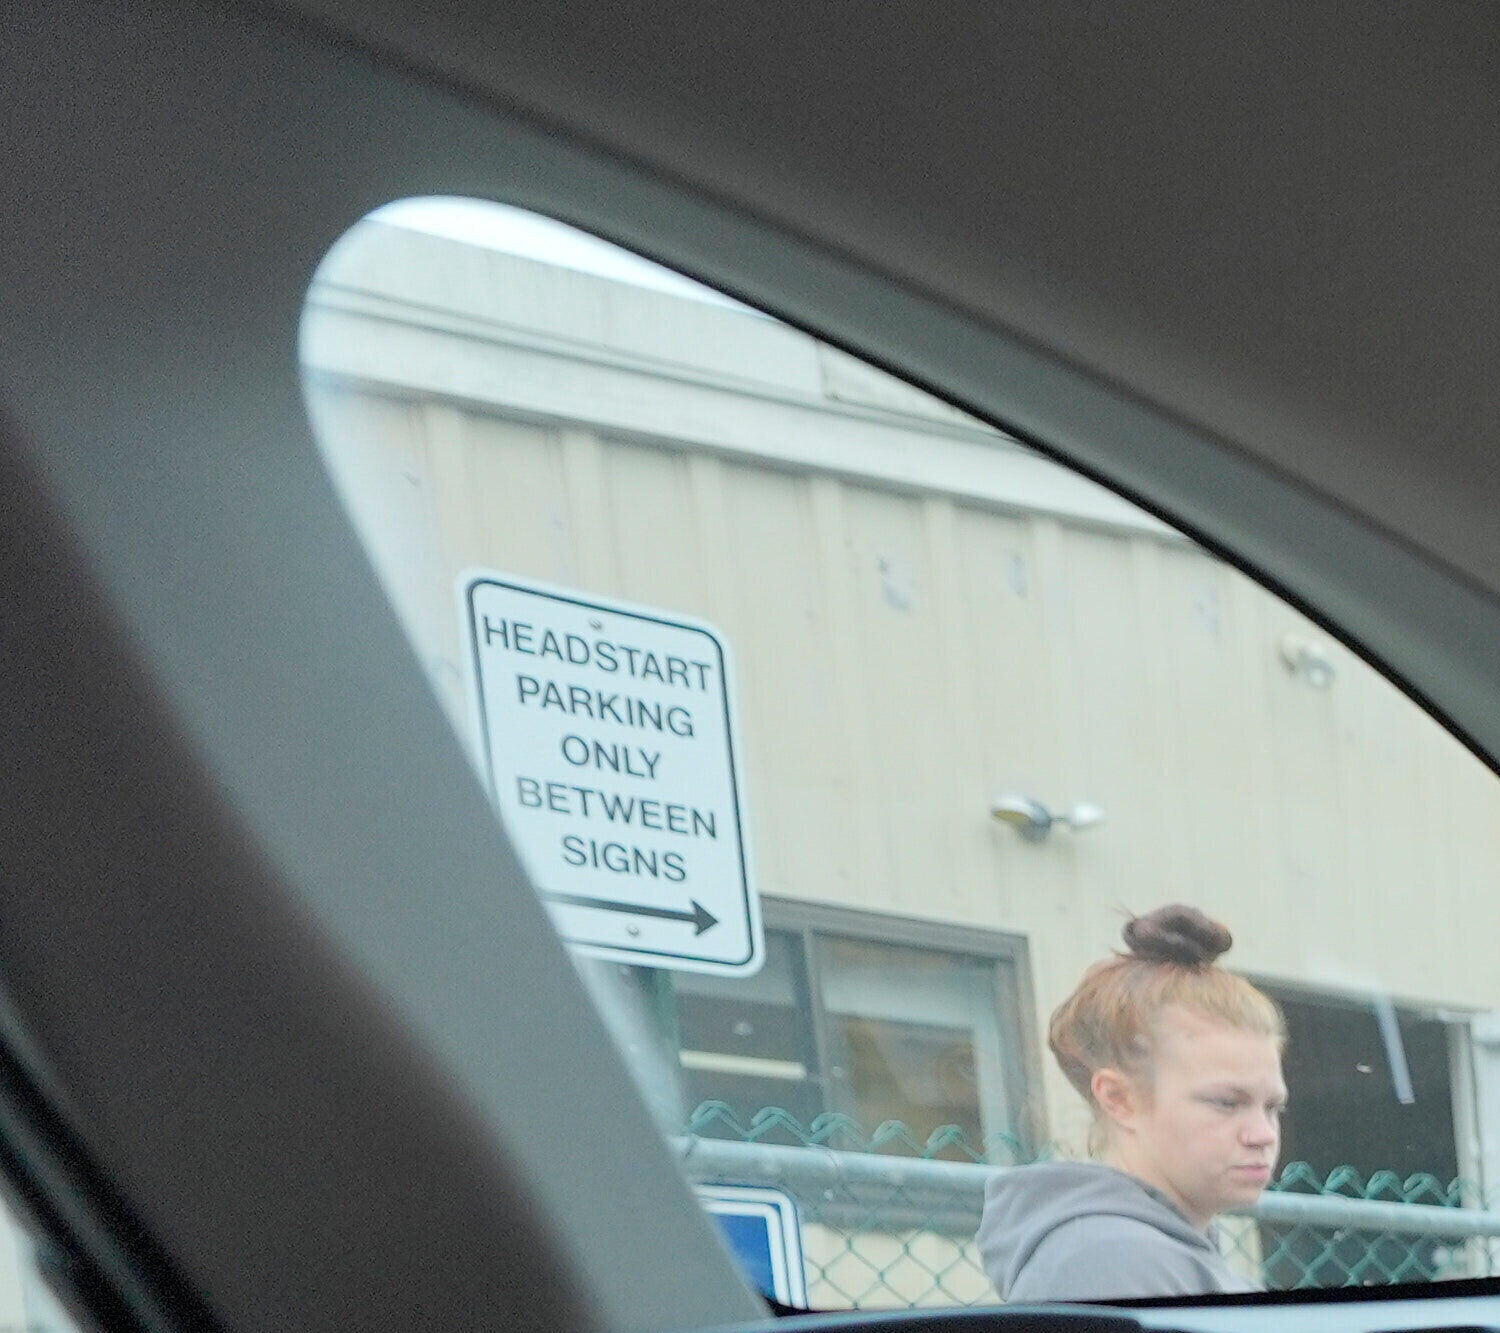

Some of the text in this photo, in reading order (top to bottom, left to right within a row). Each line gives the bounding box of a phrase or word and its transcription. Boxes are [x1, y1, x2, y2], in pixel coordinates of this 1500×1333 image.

[483, 615, 711, 693] HEADSTART
[517, 675, 694, 738] PARKING
[561, 736, 660, 780] ONLY
[517, 777, 717, 840] BETWEEN
[562, 835, 687, 882] SIGNS
